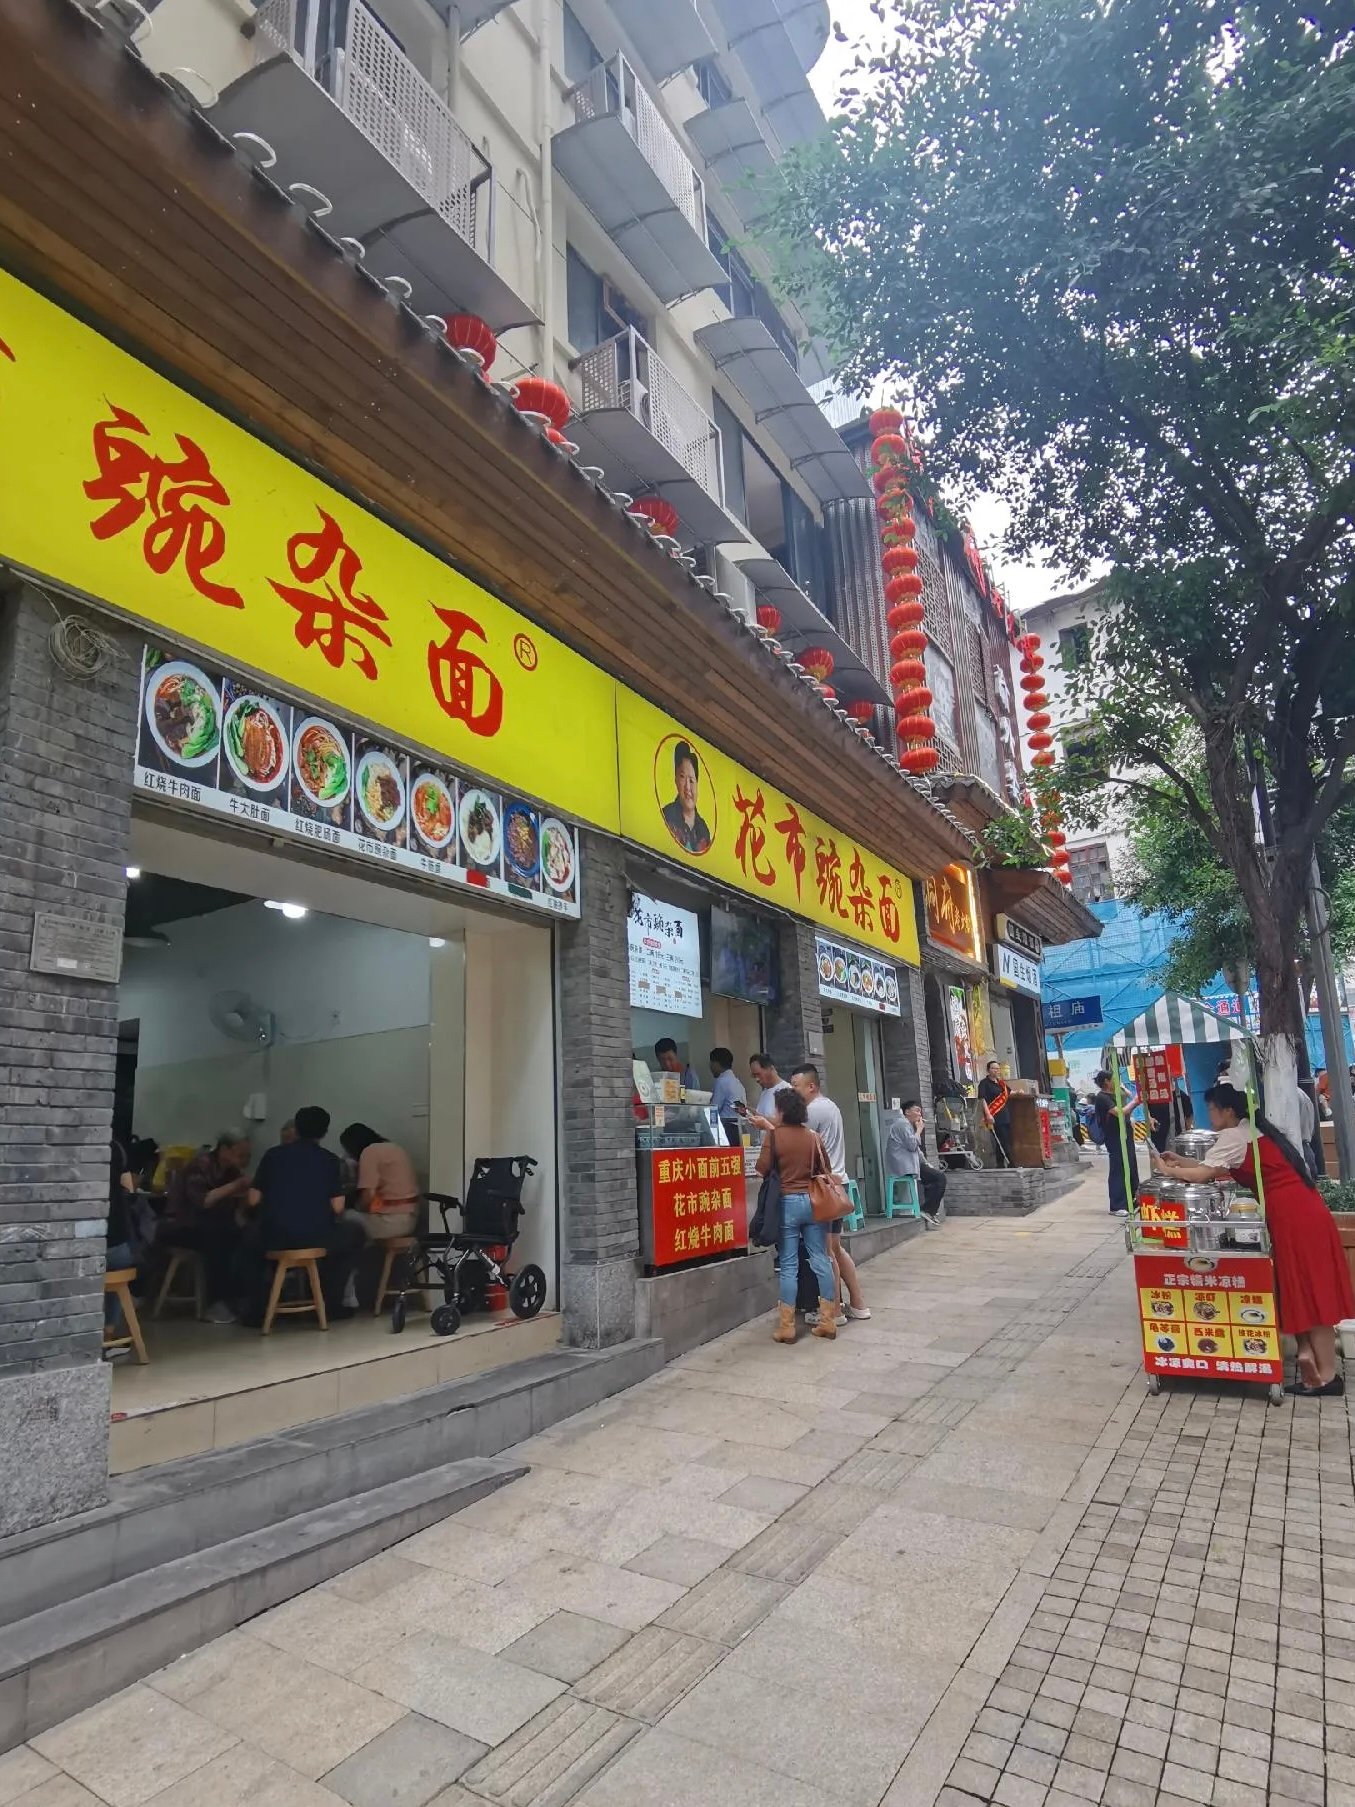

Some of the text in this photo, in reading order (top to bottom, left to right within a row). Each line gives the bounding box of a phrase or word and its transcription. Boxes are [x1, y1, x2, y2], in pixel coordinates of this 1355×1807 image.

[144, 771, 201, 802] 红烧牛肉面
[229, 797, 270, 822] 牛大肚面
[295, 818, 341, 844] 红烧肥肠面
[732, 783, 900, 943] 花市豌杂面
[658, 1155, 741, 1184] 重庆小面前五强
[673, 1187, 732, 1218] 花市豌杂面
[674, 1219, 734, 1253] 红烧牛肉面
